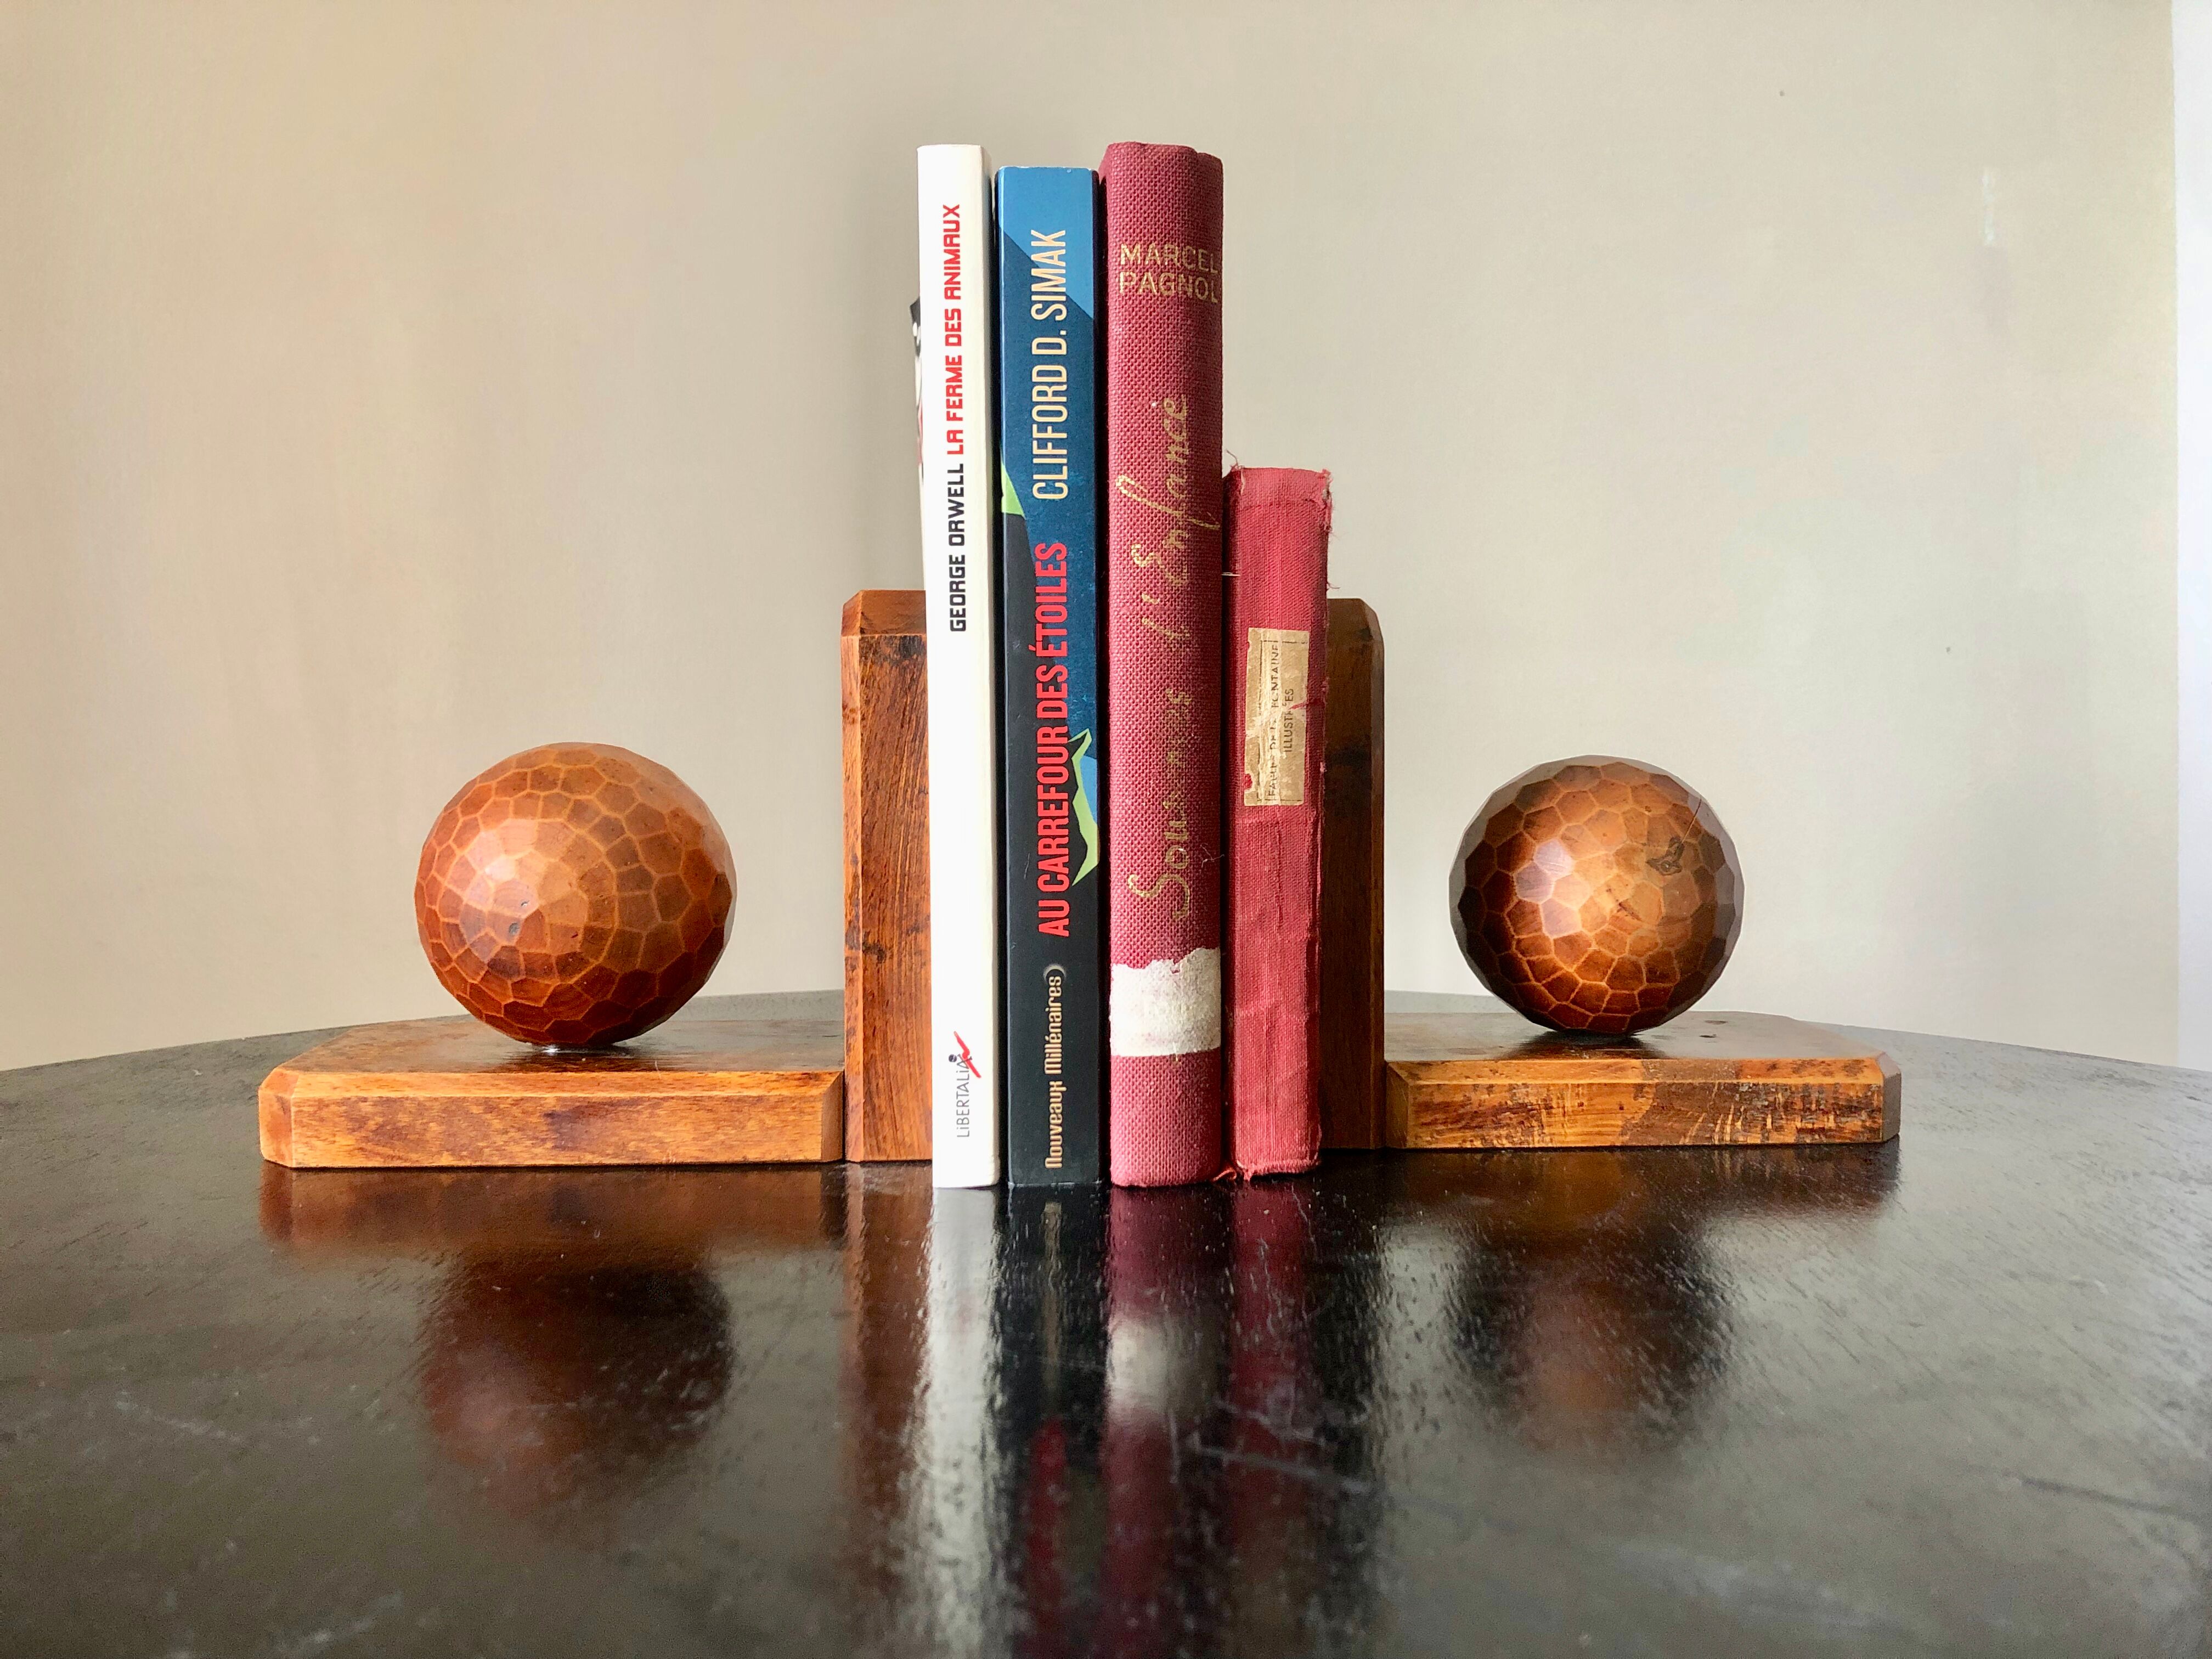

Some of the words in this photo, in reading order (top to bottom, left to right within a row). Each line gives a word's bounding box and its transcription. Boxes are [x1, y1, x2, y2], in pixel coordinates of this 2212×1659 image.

[943, 204, 961, 300] ANIMAUX
[1030, 229, 1067, 321] SIMAK
[1119, 271, 1218, 303] PAGNOL
[1120, 242, 1218, 274] MARCEL
[944, 308, 962, 346] DES
[1031, 330, 1067, 355] D.
[945, 355, 963, 421] FERME
[946, 429, 964, 455] LA
[1031, 365, 1068, 500] CLIFFORD
[947, 463, 965, 547] ORWELL
[949, 554, 967, 632] GEORGE
[1028, 542, 1068, 657] ÉTOILES
[1036, 664, 1069, 718] DES
[1036, 725, 1069, 892] CARREFOUR
[1038, 898, 1070, 937] AU
[1045, 1081, 1067, 1169] Nouveaux
